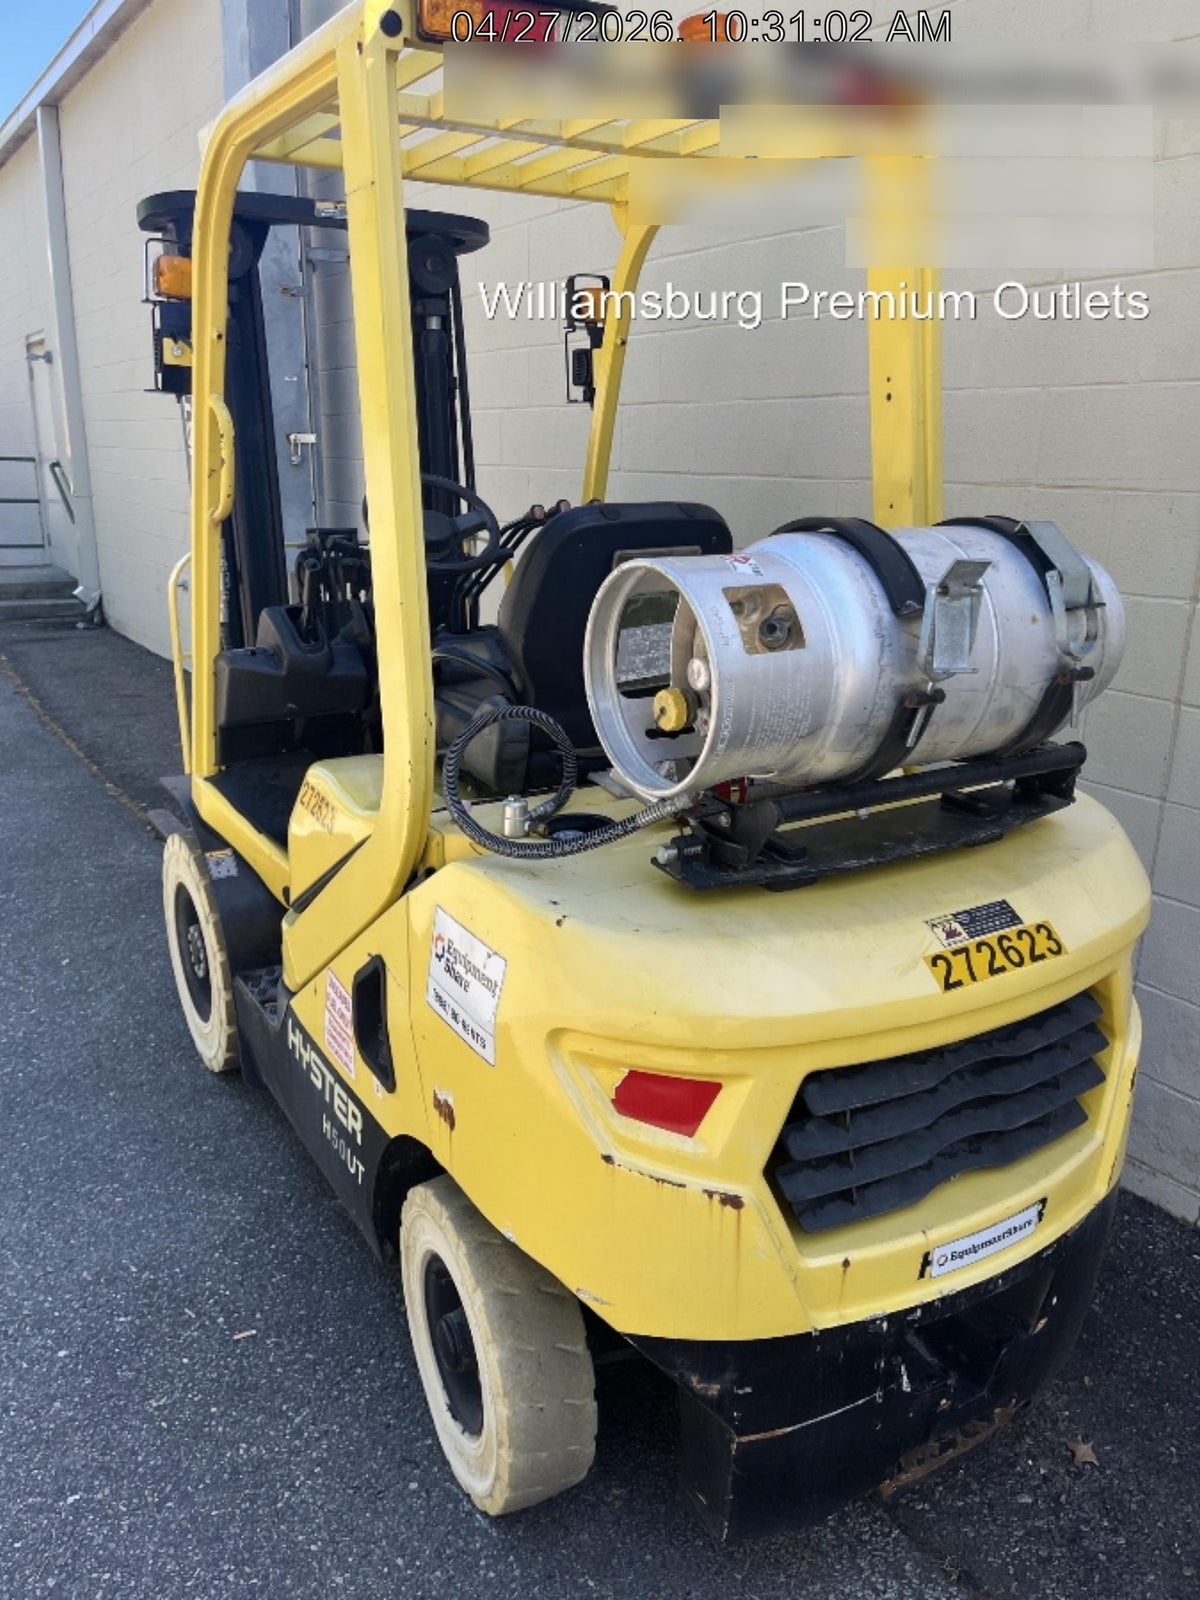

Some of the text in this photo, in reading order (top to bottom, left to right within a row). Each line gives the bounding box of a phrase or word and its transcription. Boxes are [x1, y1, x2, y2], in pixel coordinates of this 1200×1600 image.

[930, 923, 1063, 991] 272623
[287, 1018, 364, 1146] HYSTER
[322, 1113, 366, 1185] H50UT
